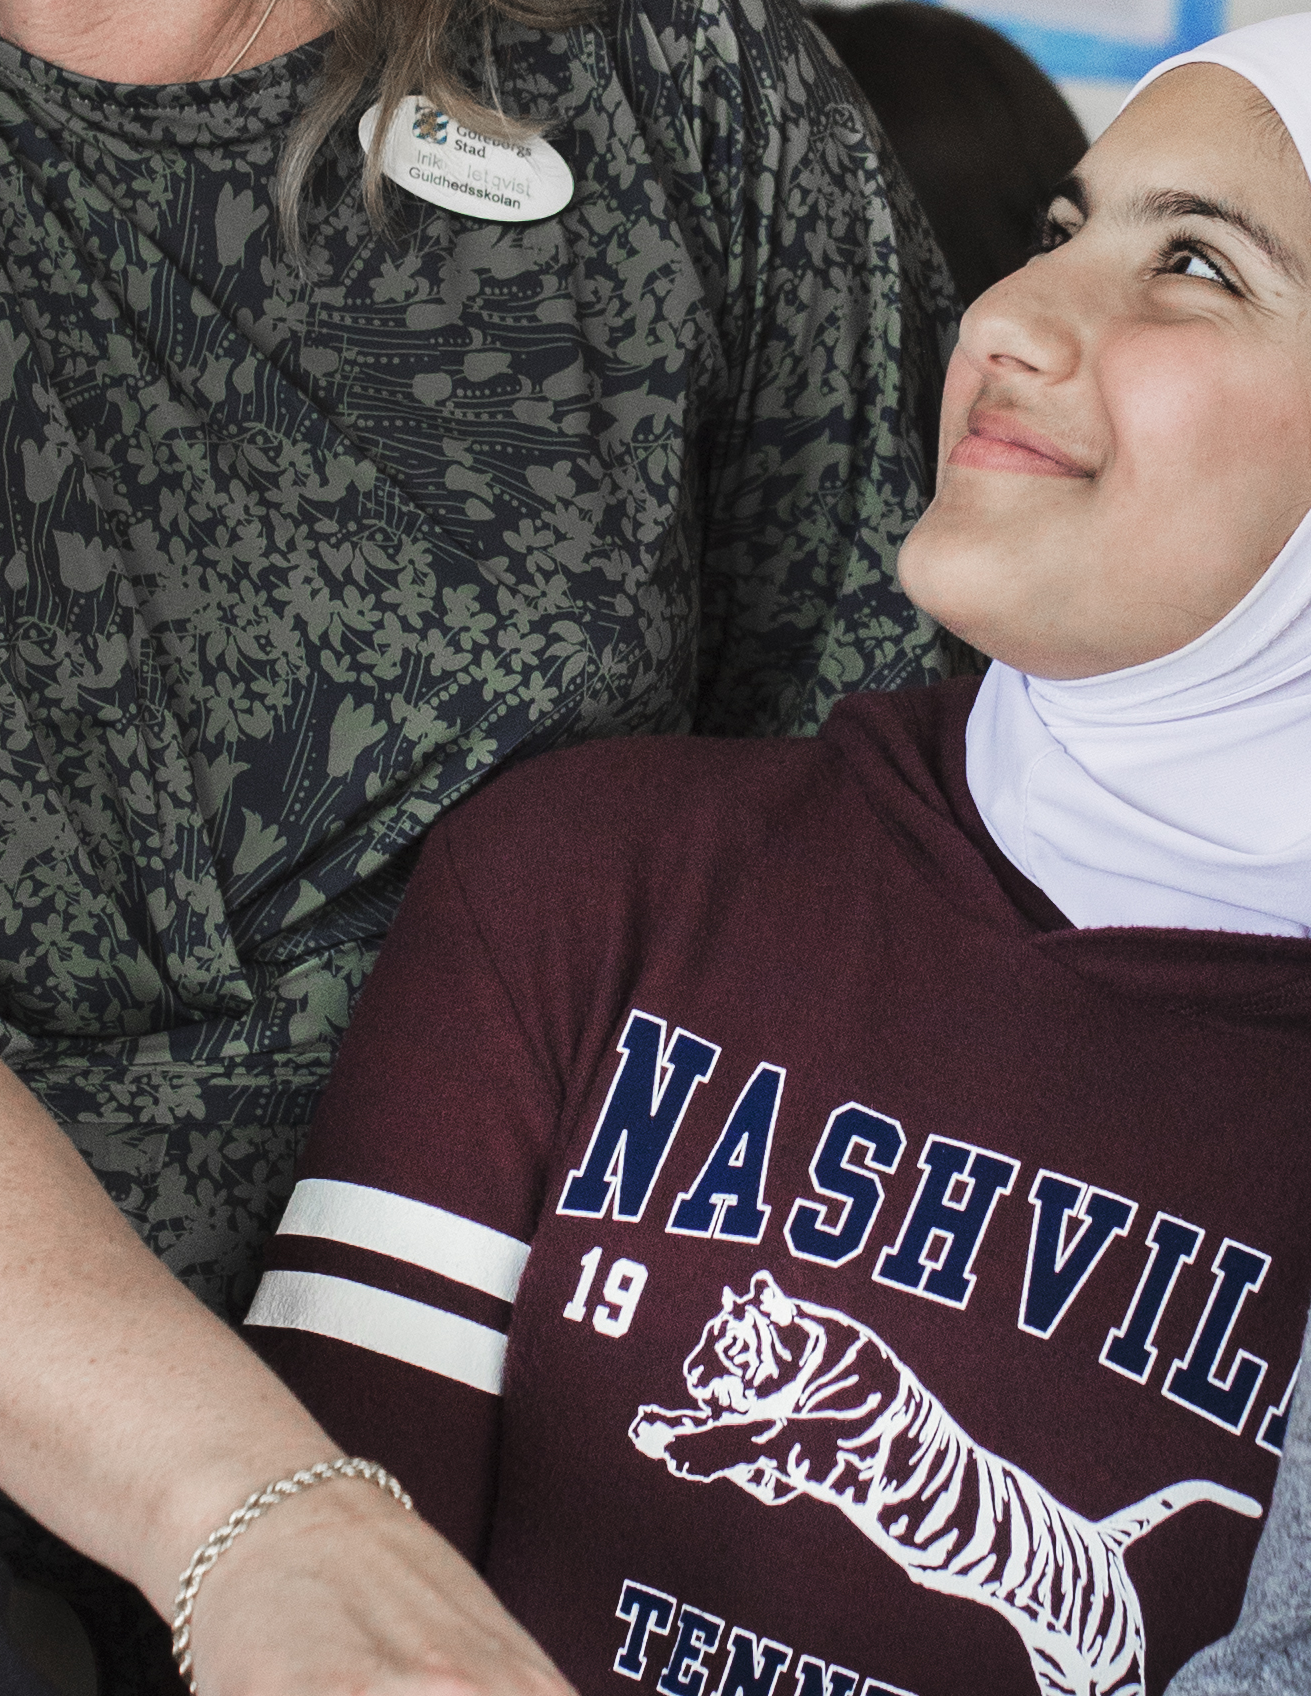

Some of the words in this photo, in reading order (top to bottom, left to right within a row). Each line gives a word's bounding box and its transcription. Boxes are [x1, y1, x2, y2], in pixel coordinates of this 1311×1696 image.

[454, 139, 487, 159] Stad
[408, 166, 522, 210] Guldhedsskolan
[563, 1245, 649, 1339] 19
